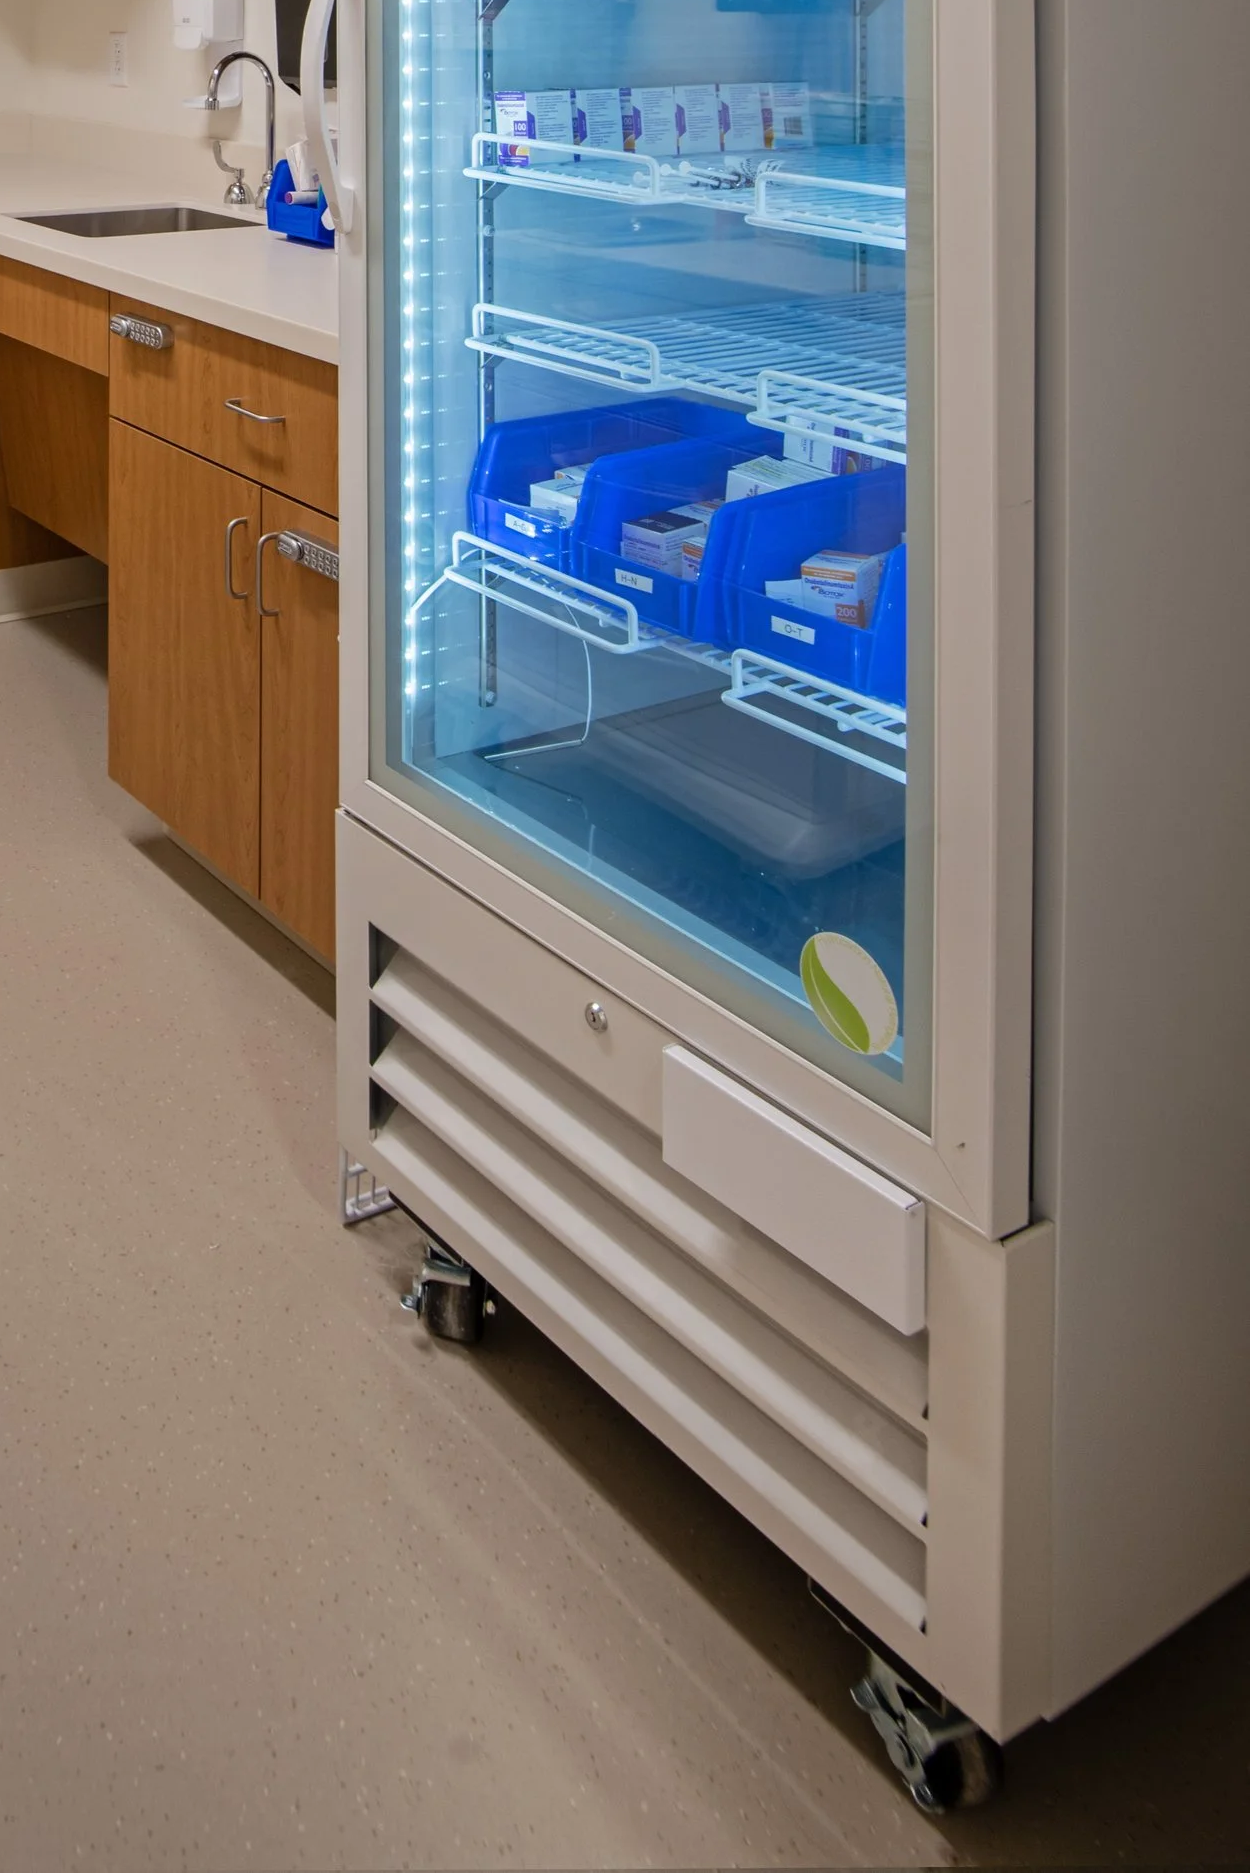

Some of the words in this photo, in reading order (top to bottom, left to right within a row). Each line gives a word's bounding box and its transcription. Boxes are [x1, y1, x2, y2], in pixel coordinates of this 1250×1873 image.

[514, 122, 527, 132] 100
[620, 573, 638, 586] H-N
[837, 607, 858, 618] 200
[784, 623, 803, 638] O-T
